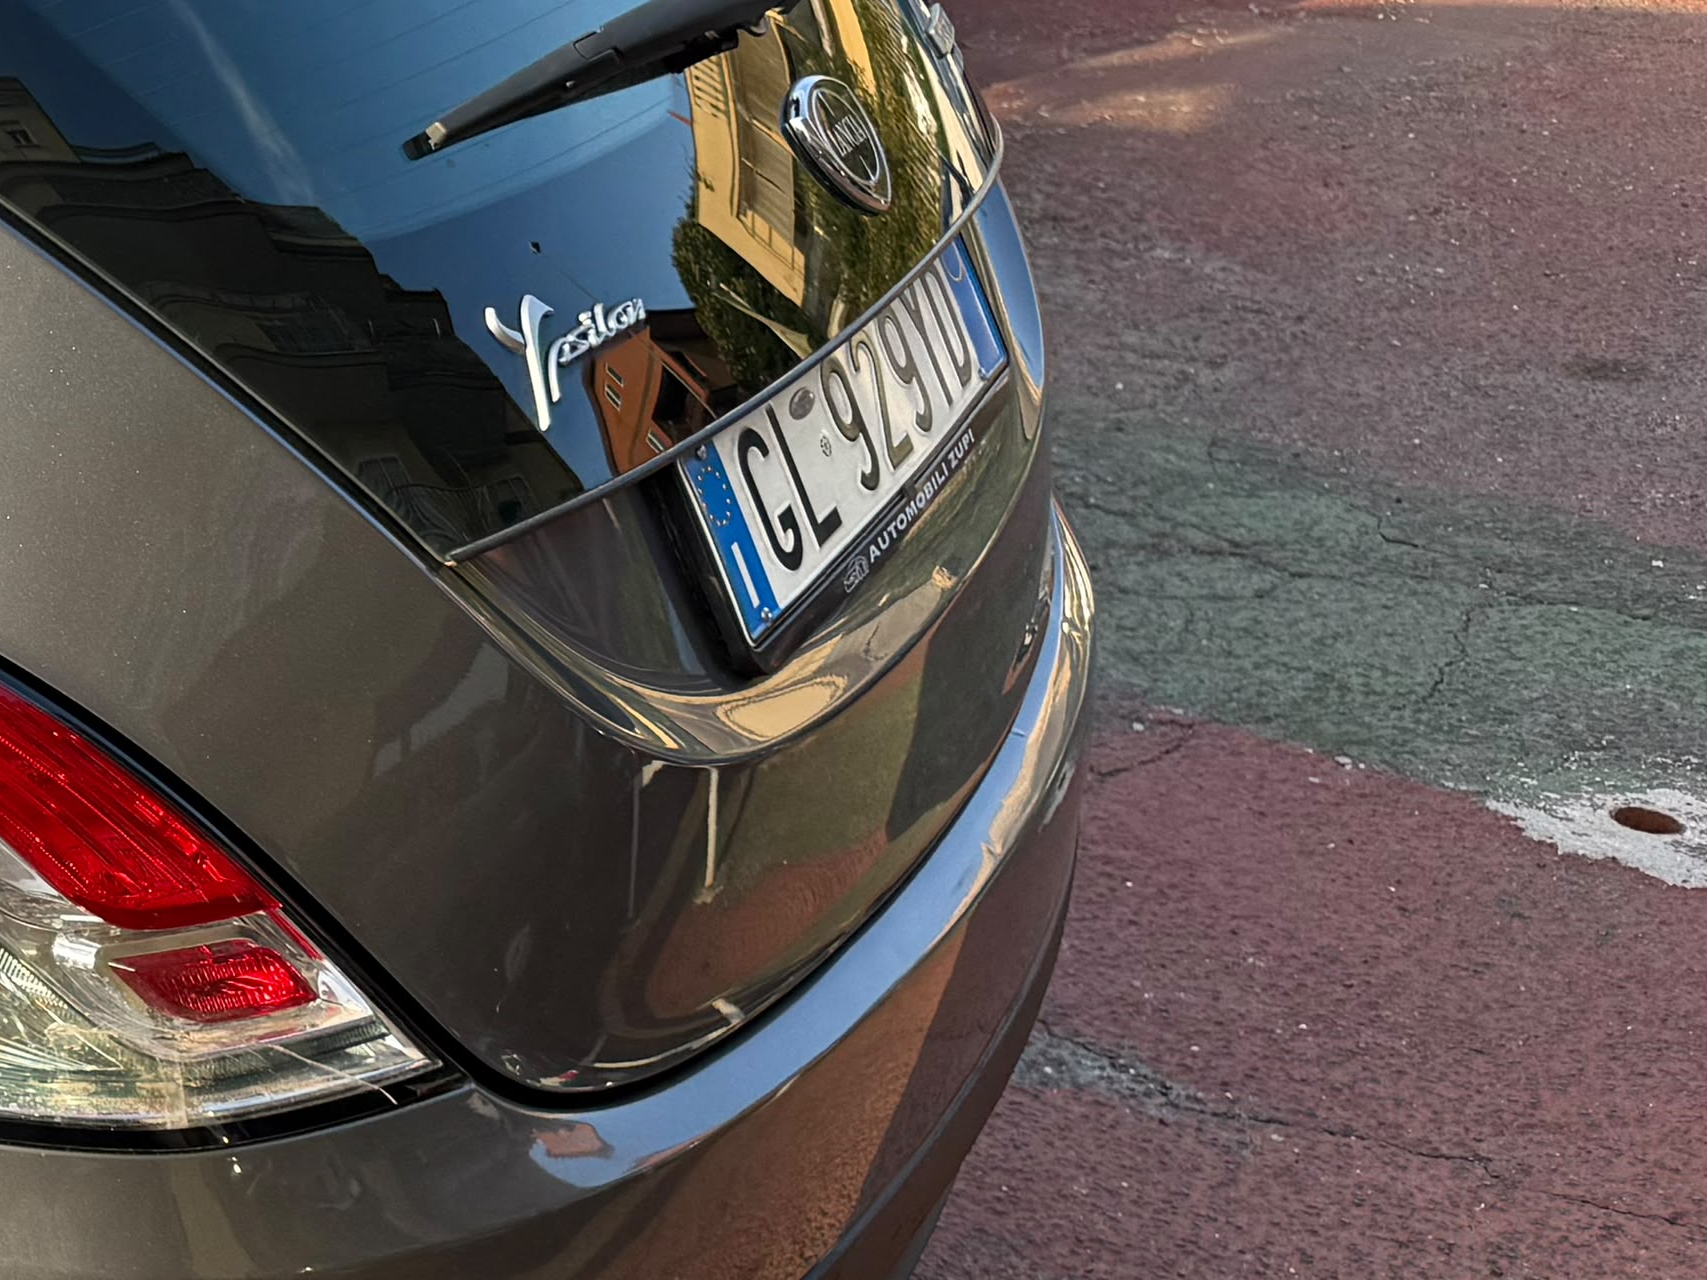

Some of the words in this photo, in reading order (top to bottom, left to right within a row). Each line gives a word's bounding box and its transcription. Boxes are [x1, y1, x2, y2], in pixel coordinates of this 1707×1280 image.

[483, 293, 647, 433] Ypsilon
[868, 461, 949, 563] AUTOMOBILI
[947, 427, 976, 469] ZUPI
